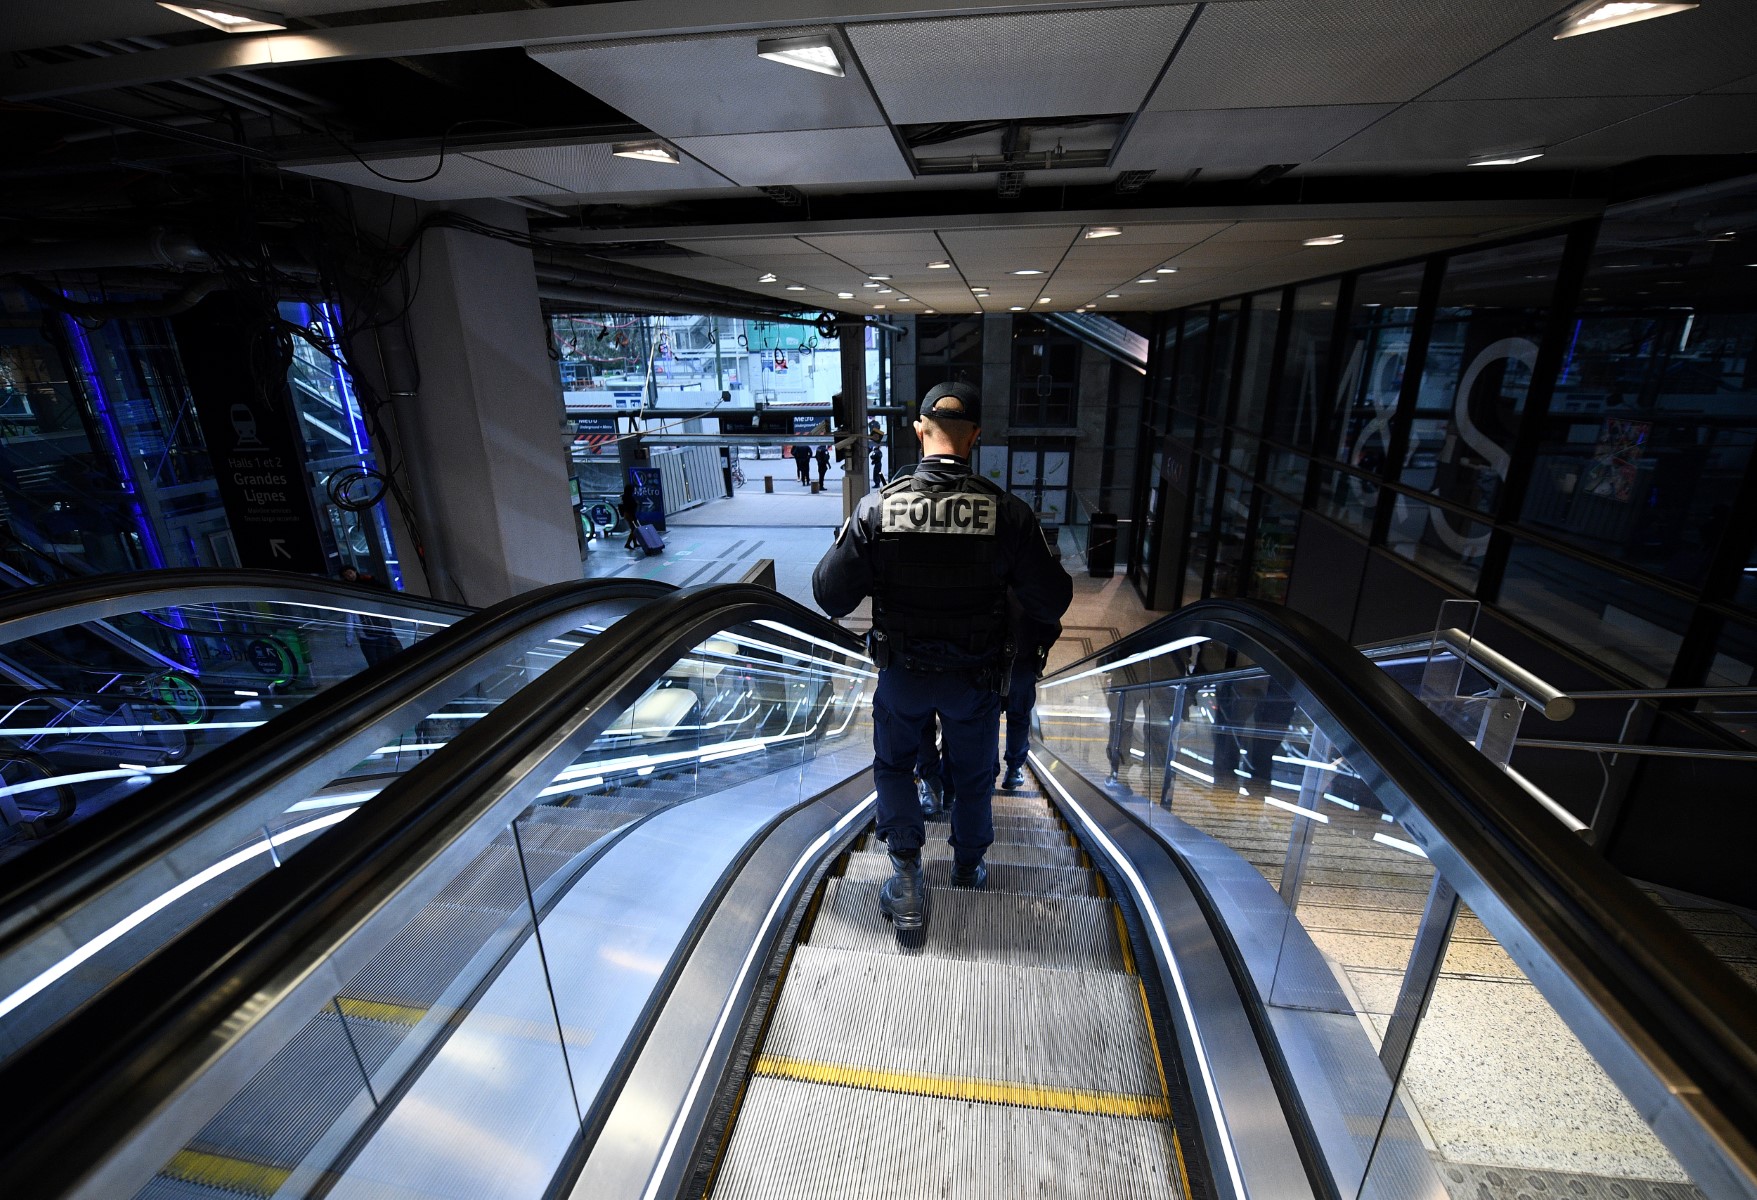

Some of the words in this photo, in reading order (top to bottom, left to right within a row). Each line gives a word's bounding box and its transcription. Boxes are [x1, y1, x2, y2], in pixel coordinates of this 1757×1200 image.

[228, 457, 254, 469] Halls
[255, 457, 261, 468] 1
[263, 457, 274, 468] et
[274, 456, 284, 468] 2
[233, 472, 288, 486] Grandes
[243, 488, 287, 505] Lignes
[889, 497, 990, 530] POLICE
